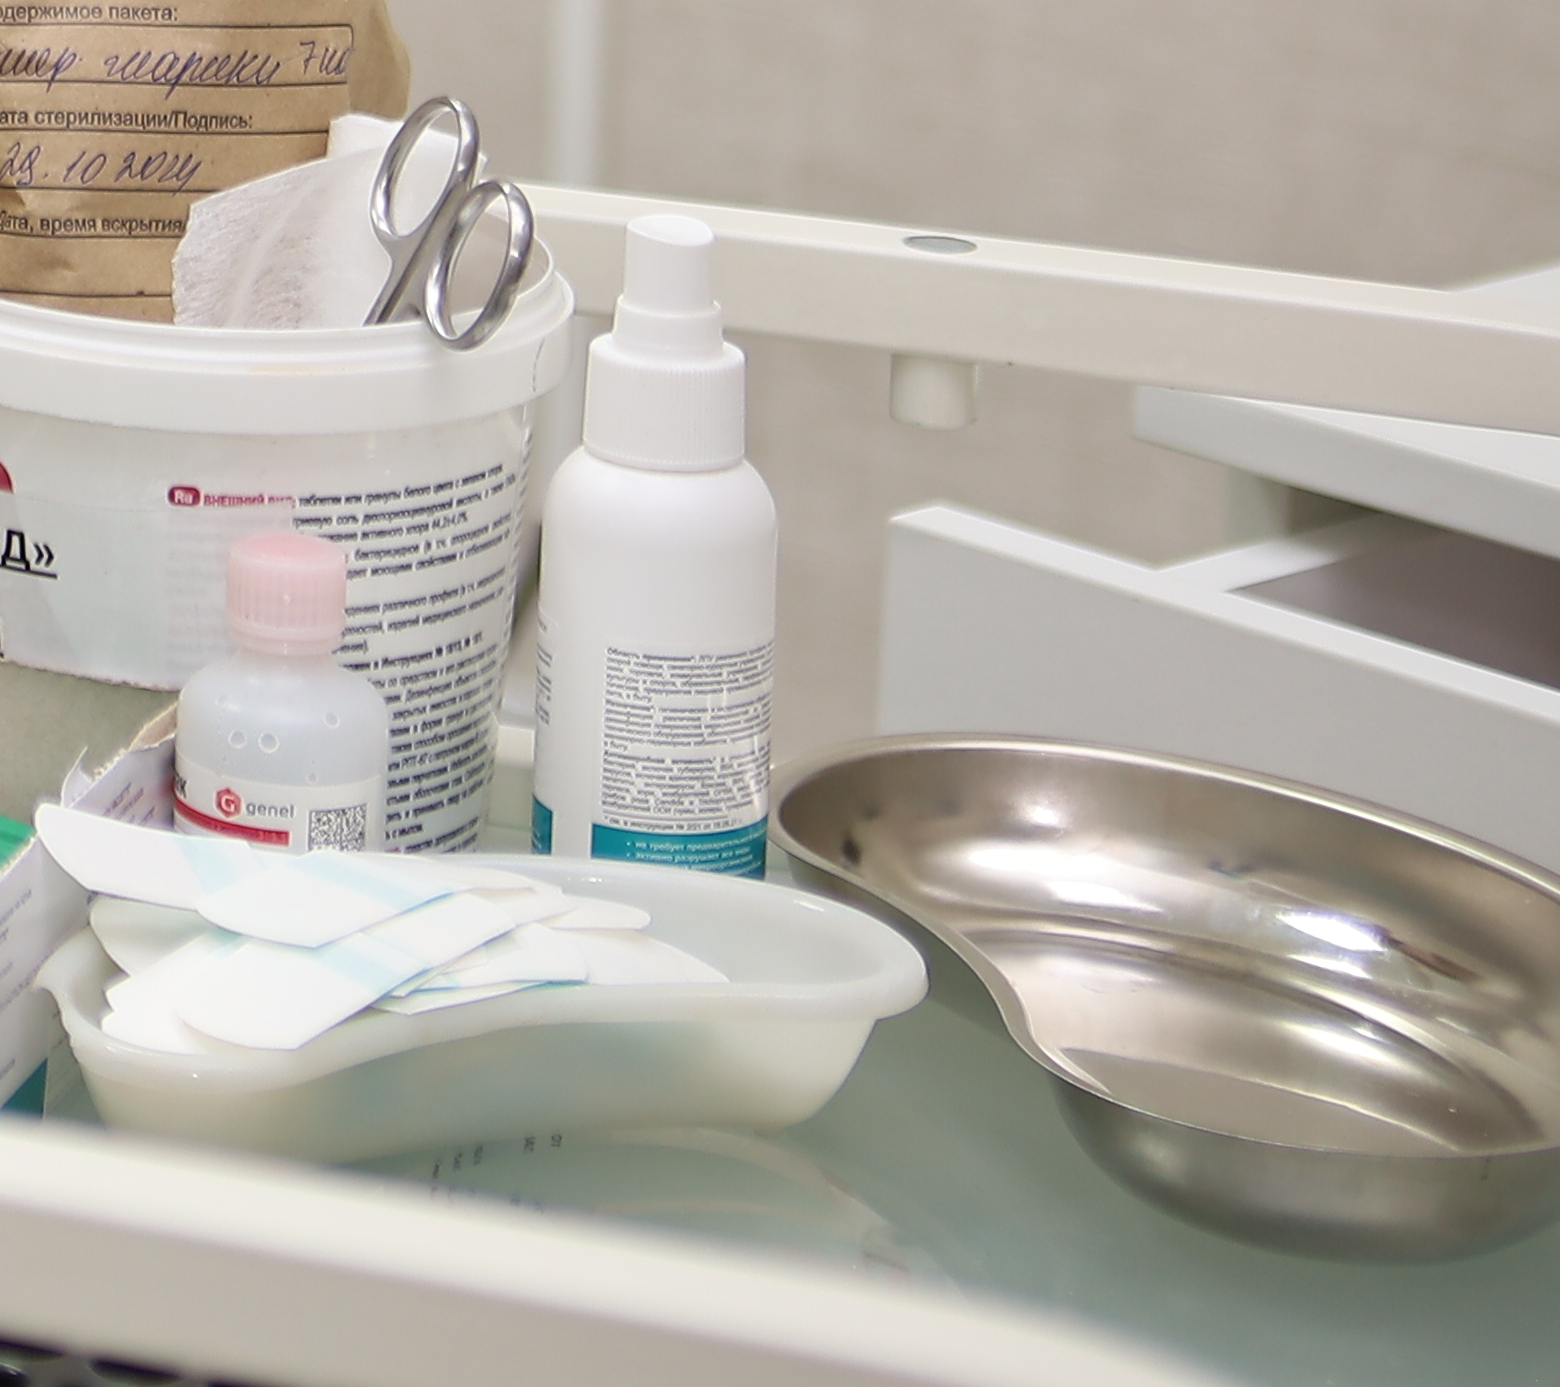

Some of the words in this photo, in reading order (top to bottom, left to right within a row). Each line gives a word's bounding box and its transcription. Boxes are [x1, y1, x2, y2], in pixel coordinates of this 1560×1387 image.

[108, 4, 179, 22] пакета:
[34, 109, 254, 131] стерилизации/Подпись:
[39, 216, 97, 235] время
[245, 800, 295, 820] genel
